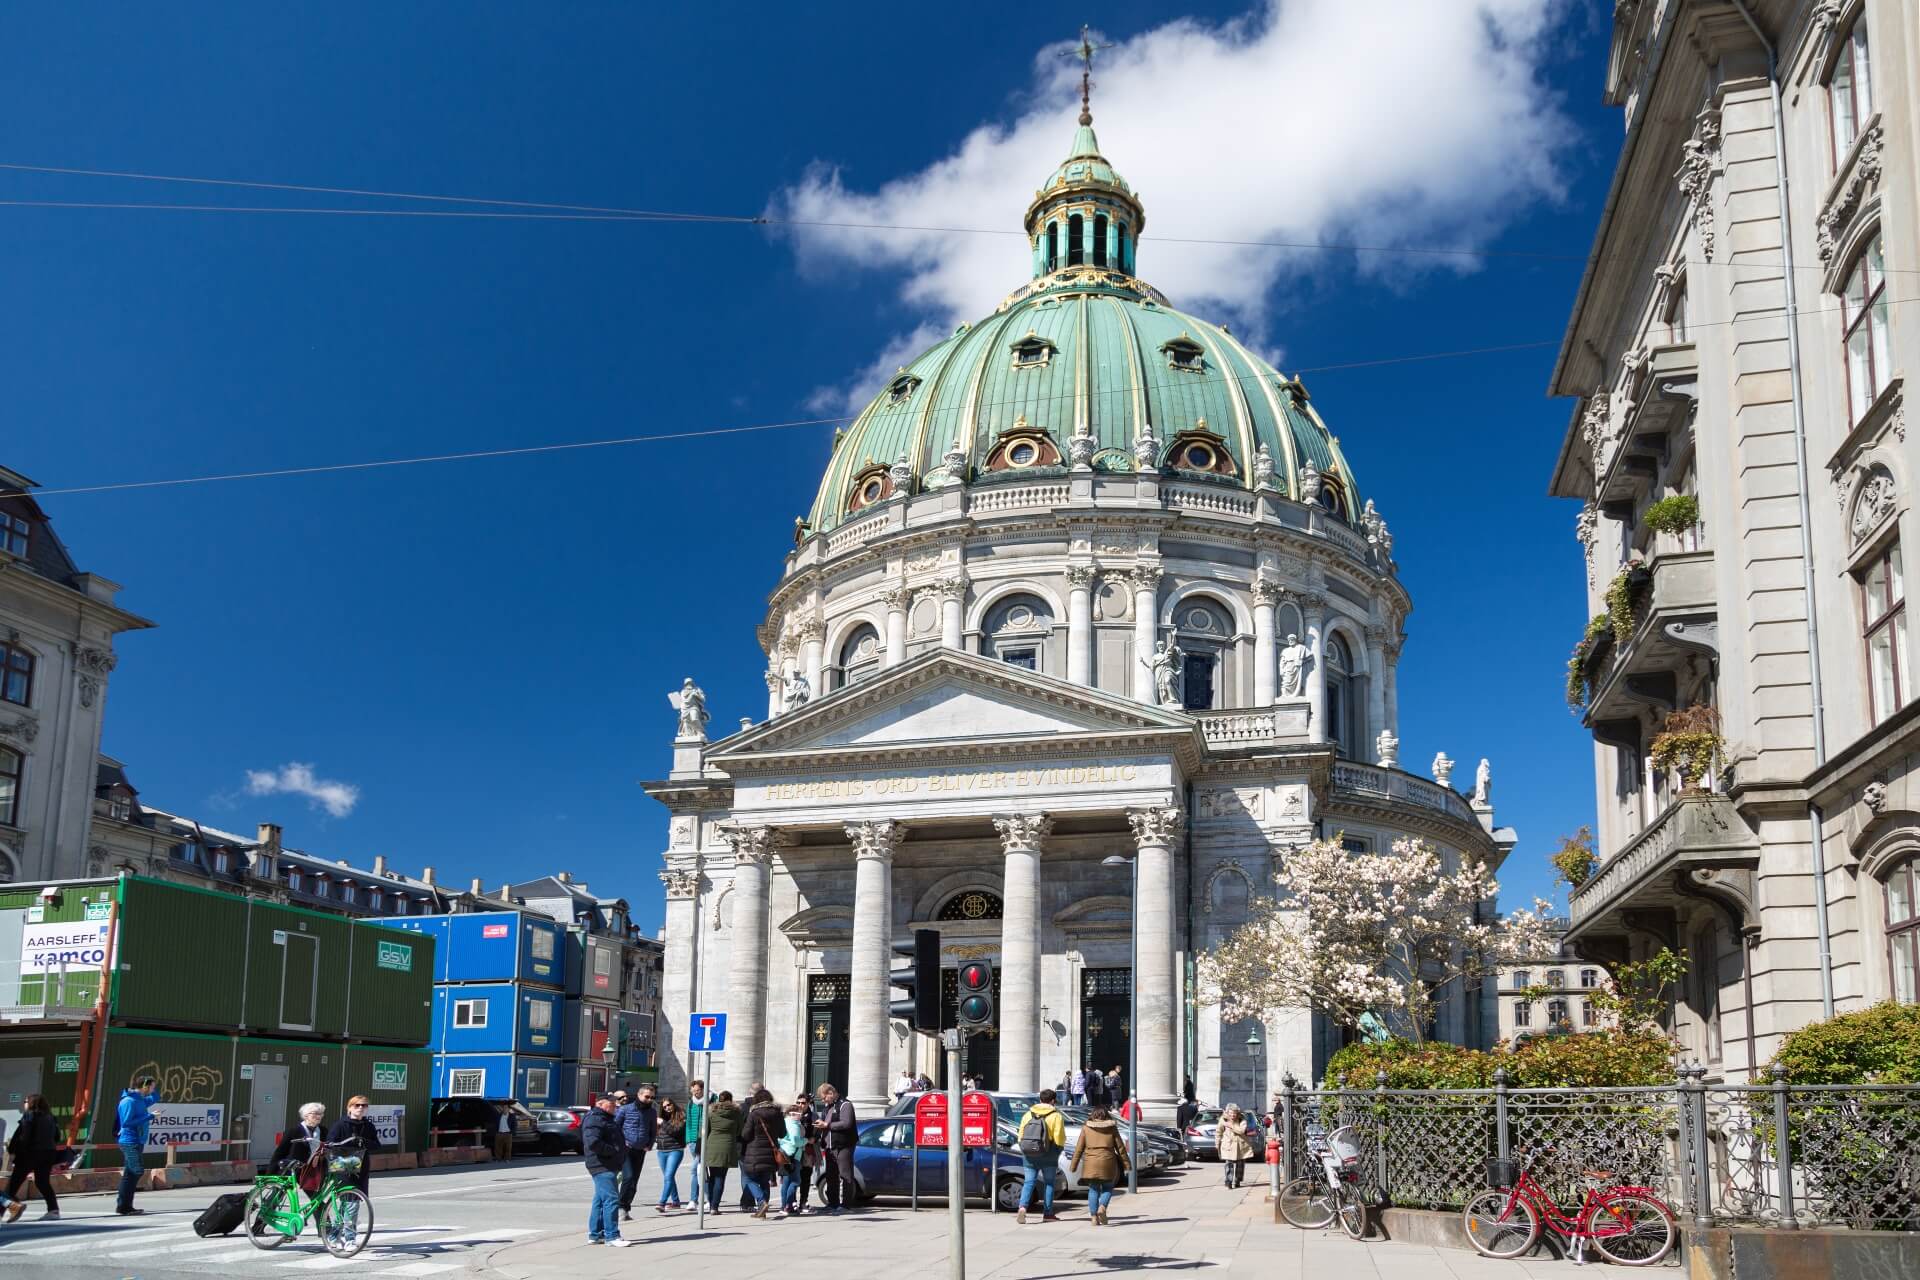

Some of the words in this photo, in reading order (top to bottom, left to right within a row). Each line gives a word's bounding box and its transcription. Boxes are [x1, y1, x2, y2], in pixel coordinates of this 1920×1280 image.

[876, 777, 918, 794] ORD
[928, 773, 1007, 791] BLIVER
[27, 934, 96, 947] AARSLEFF
[380, 950, 409, 964] GSV
[375, 1070, 405, 1082] GSV
[151, 1116, 204, 1126] ARSLEFF
